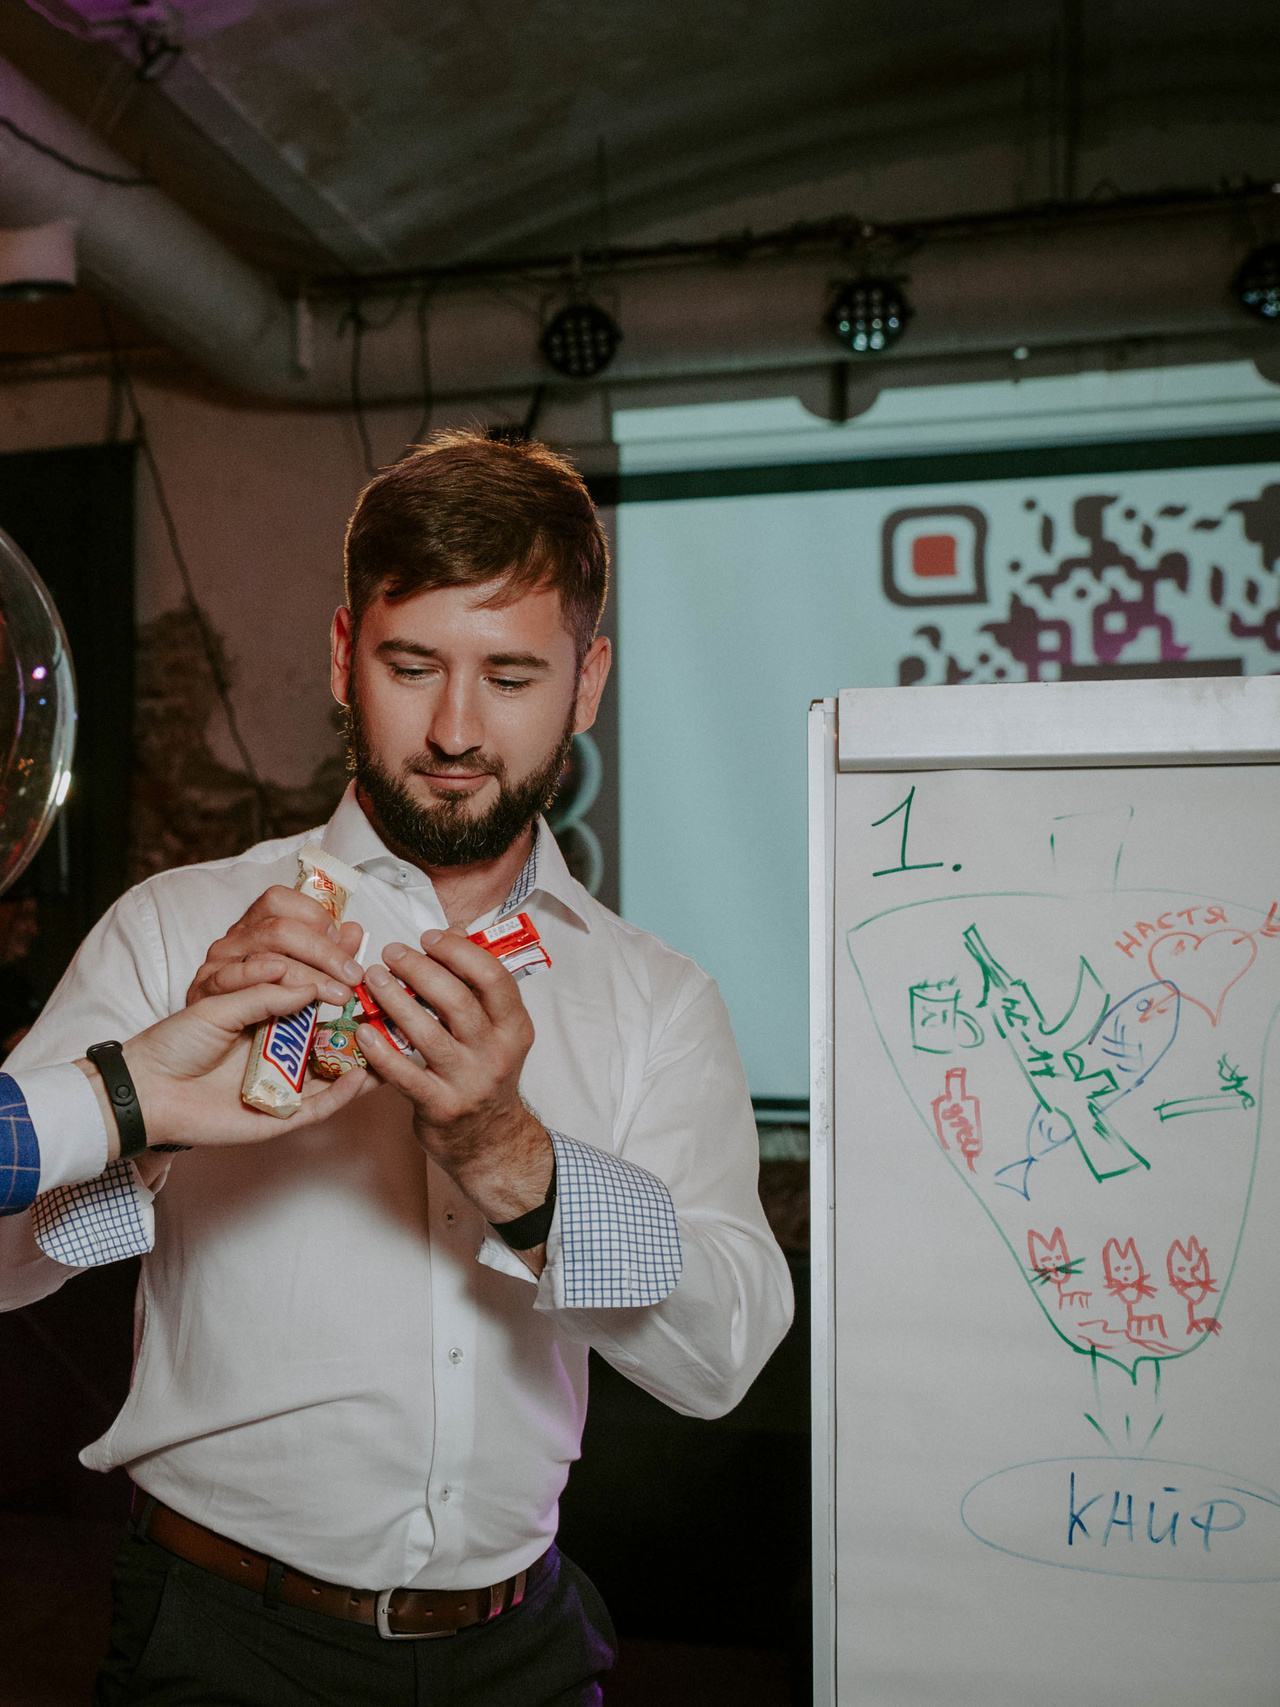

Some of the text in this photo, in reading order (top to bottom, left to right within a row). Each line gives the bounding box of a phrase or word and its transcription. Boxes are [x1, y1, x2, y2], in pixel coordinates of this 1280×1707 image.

[871, 786, 962, 877] 1.
[1114, 905, 1229, 959] НАСТЯ
[1067, 1471, 1246, 1552] КАЙФ
